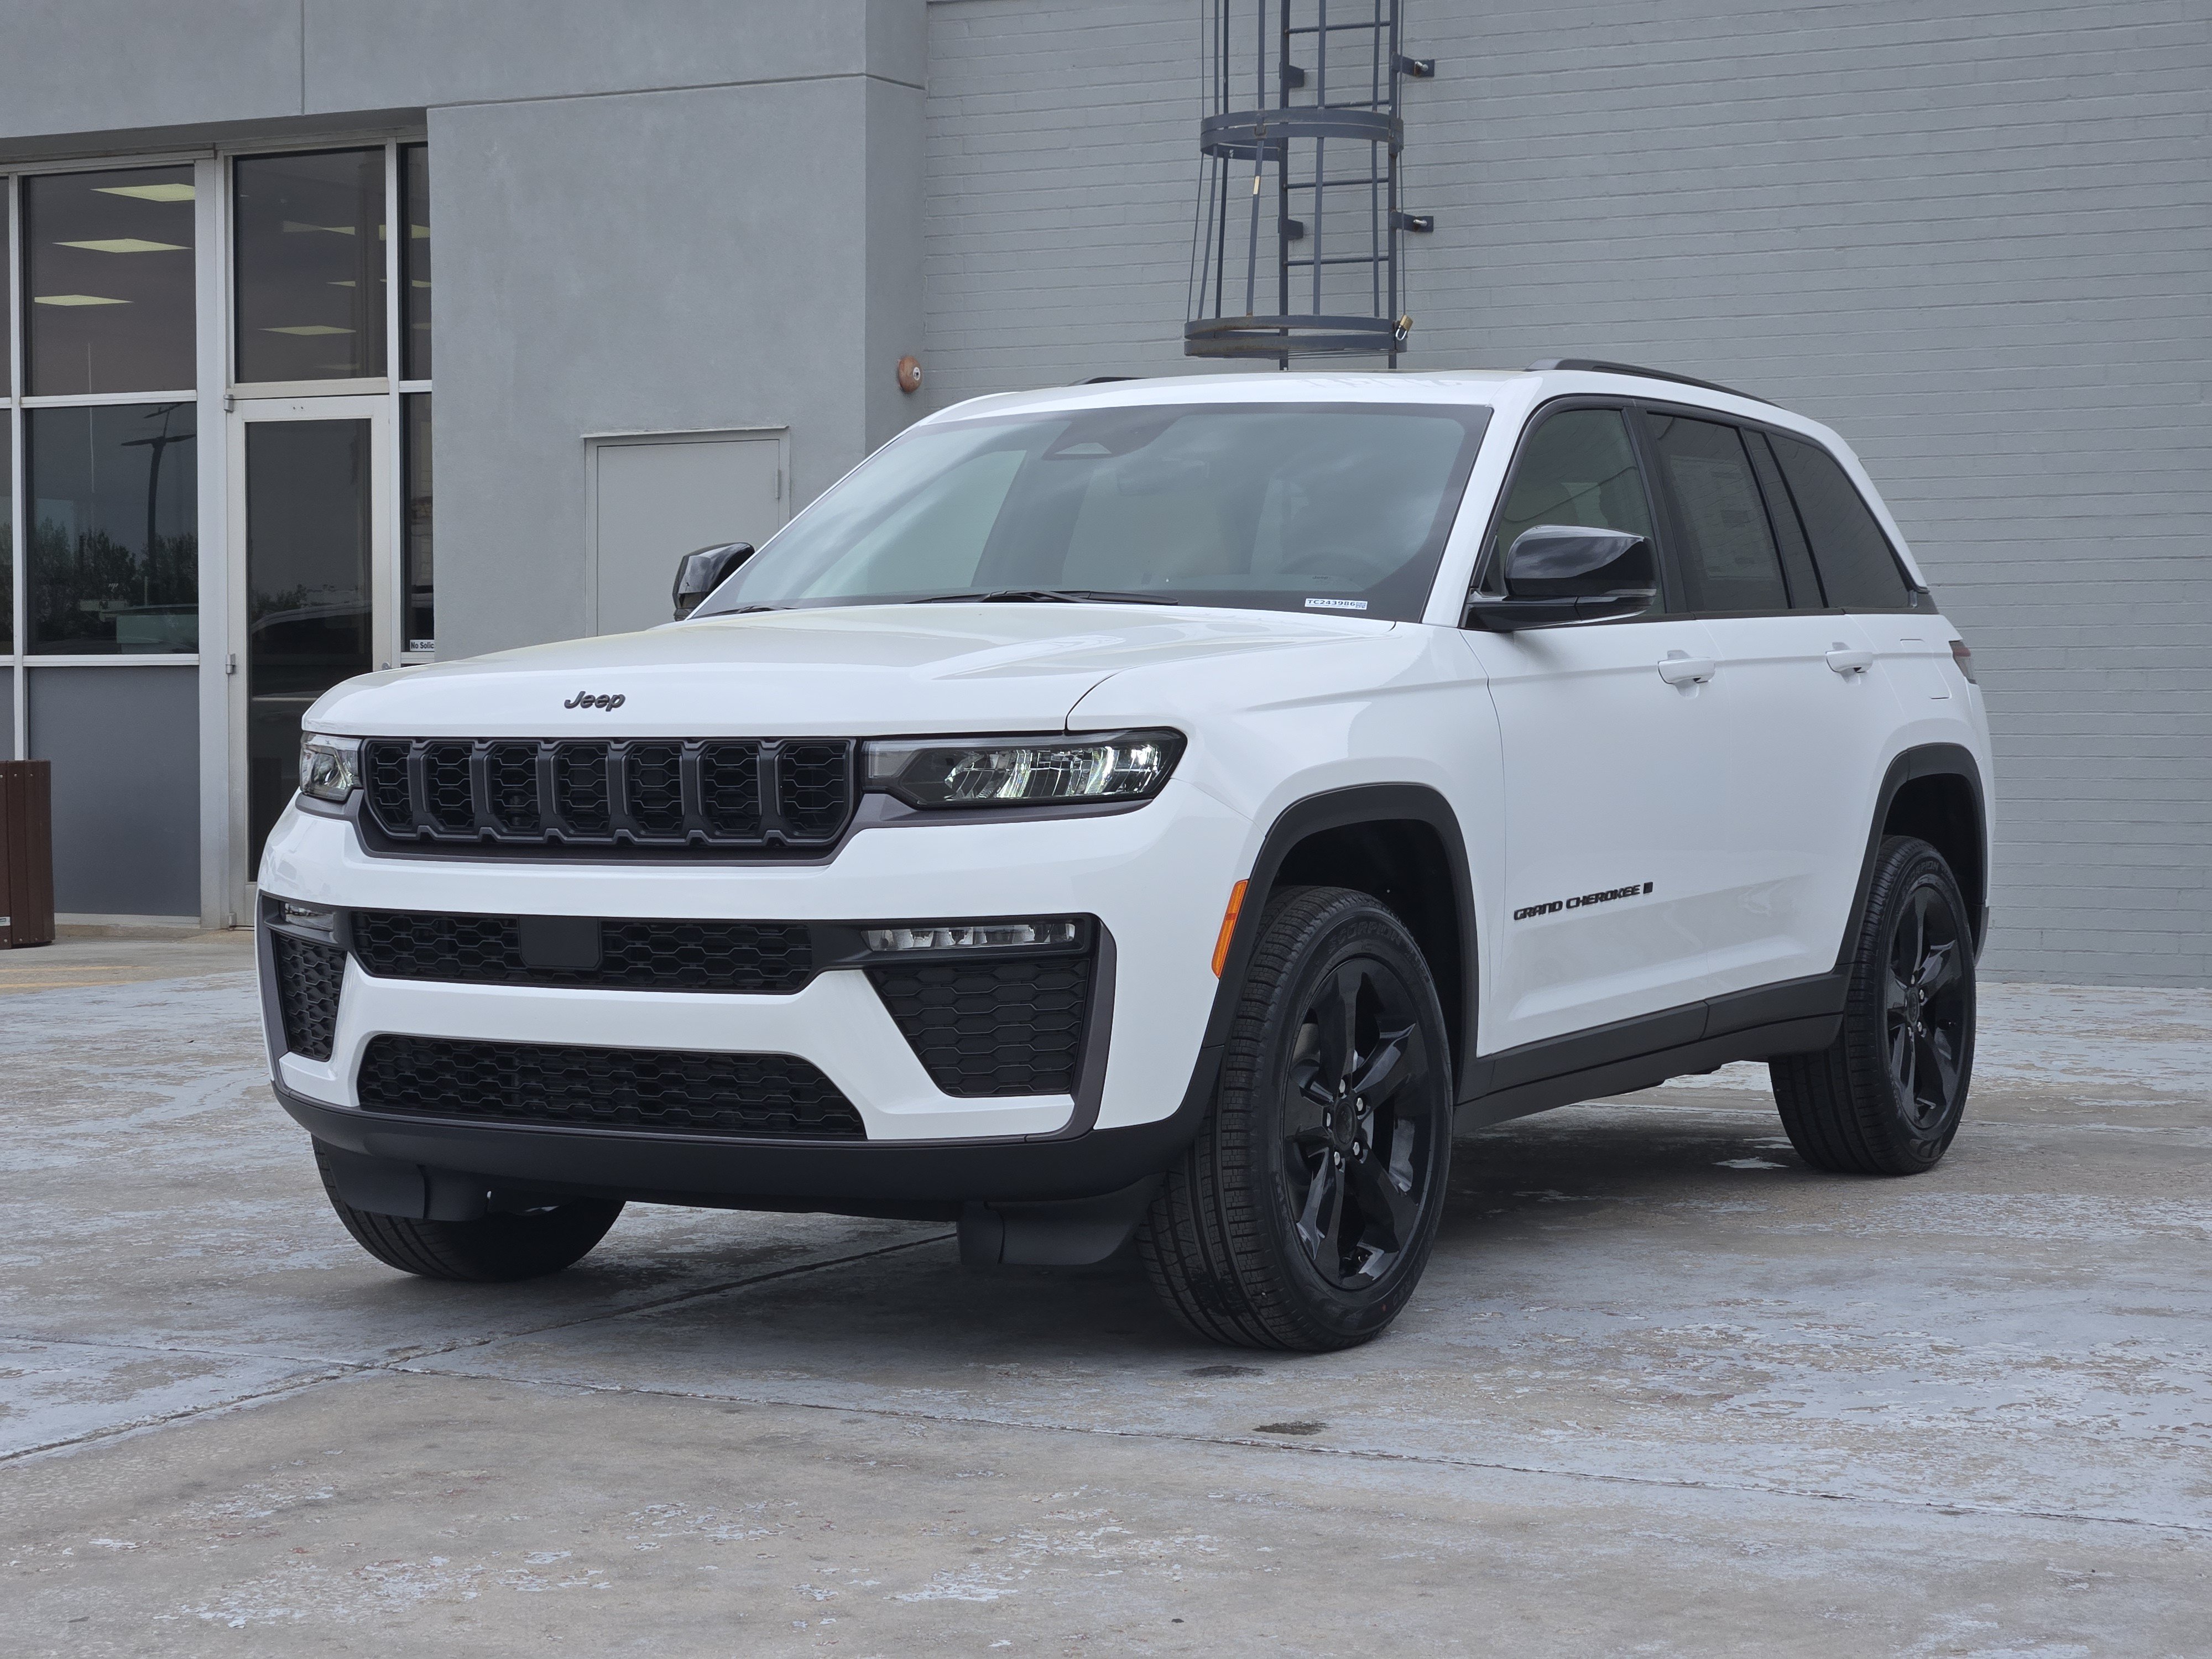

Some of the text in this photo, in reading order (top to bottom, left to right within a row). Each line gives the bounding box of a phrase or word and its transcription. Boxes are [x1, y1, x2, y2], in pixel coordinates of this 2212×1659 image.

[564, 691, 625, 712] Jeep
[1514, 884, 1641, 920] GRAND CHEROKEE
[1328, 921, 1404, 954] SCORPION
